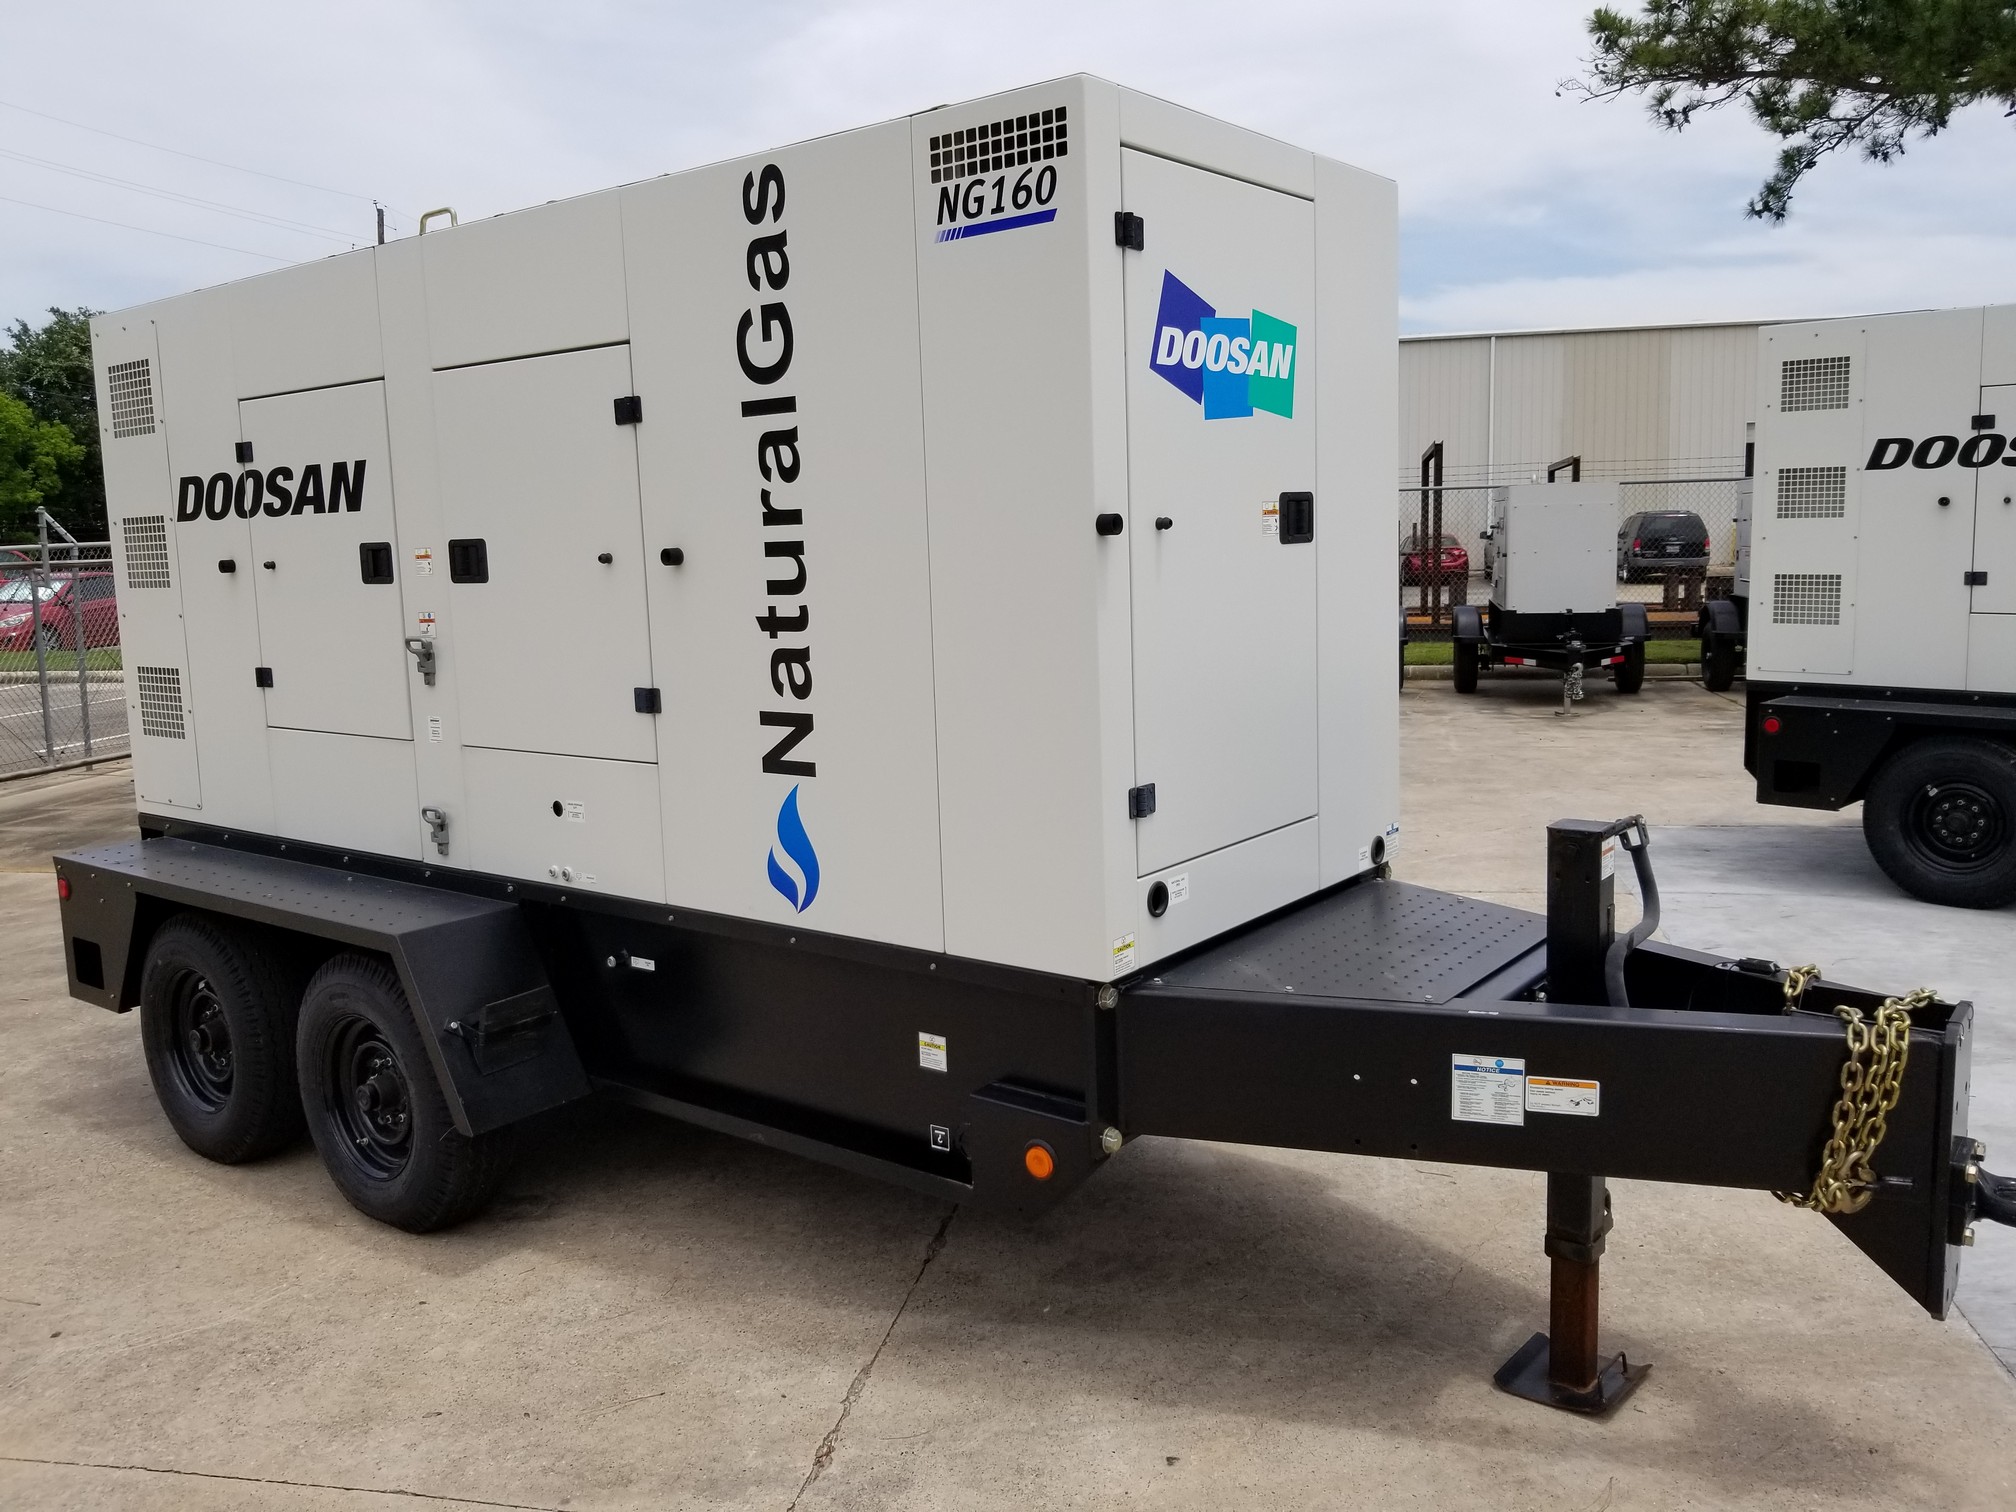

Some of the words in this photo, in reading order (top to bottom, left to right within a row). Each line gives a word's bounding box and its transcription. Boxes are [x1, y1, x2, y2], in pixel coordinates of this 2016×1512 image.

[937, 165, 1057, 226] NG160
[1156, 326, 1294, 379] DOOSAN
[177, 459, 367, 523] DOOSAN
[1552, 1080, 1580, 1088] WARNING
